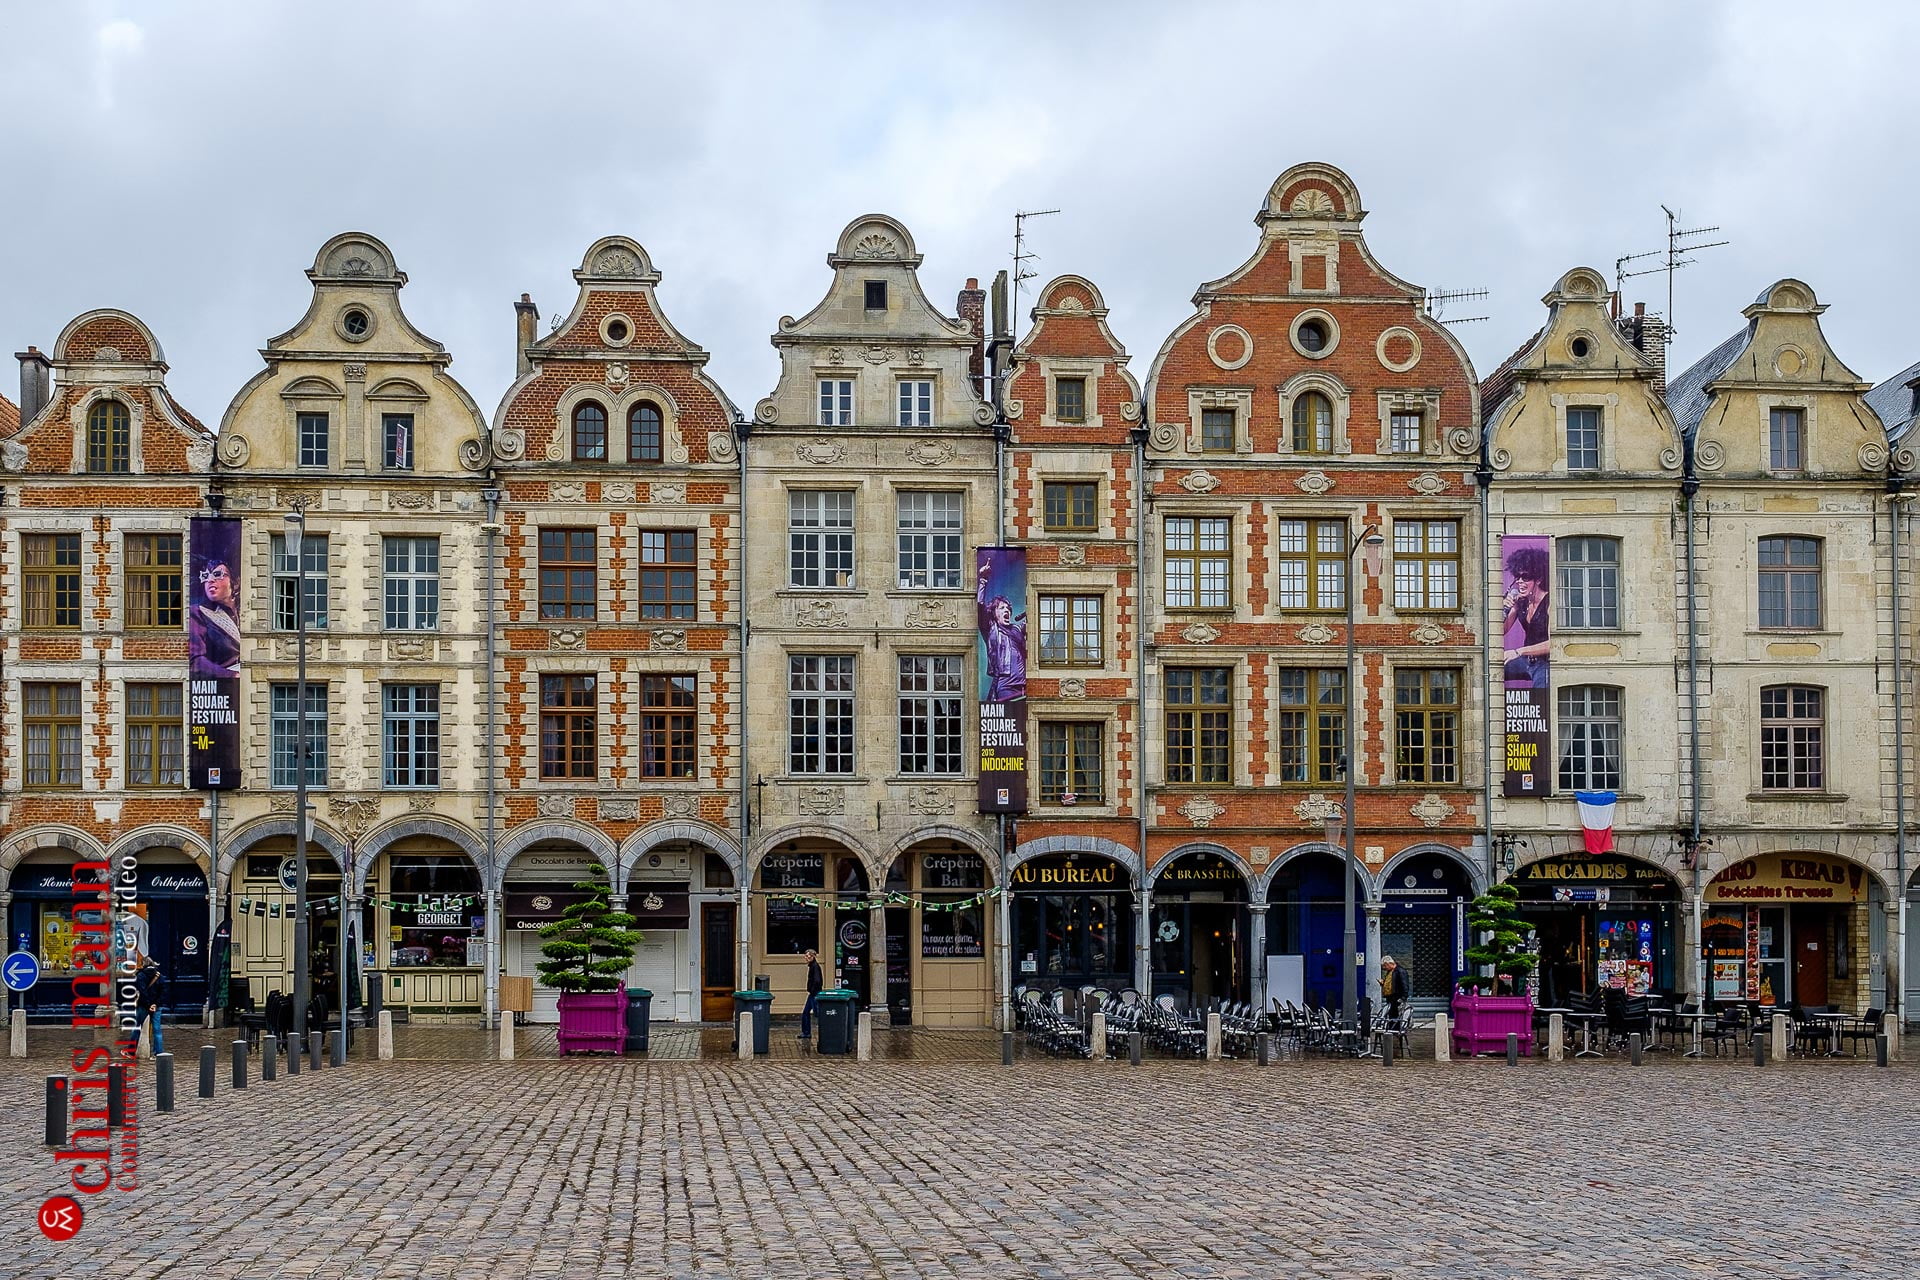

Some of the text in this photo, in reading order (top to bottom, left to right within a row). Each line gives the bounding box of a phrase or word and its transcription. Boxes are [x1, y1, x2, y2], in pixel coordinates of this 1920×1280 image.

[192, 681, 217, 694] MAIN
[192, 696, 230, 709] SQUARE
[1506, 691, 1530, 704] MAIN
[981, 704, 1004, 717] MAIN
[1506, 705, 1540, 718] SQUARE
[192, 711, 237, 724] FESTIVAL
[192, 726, 206, 734] 2010
[981, 719, 1016, 732] SQUARE
[1506, 719, 1548, 732] FESTIVAL
[981, 733, 1024, 746] FESTIVAL
[982, 749, 994, 757] 2013
[1507, 744, 1538, 757] SHAKA
[982, 758, 1024, 771] INDOCHINE
[1507, 758, 1531, 771] PONK
[762, 856, 822, 872] Crêperie
[923, 856, 982, 872] Crêperie
[1012, 868, 1115, 883] AU BUREAU
[1163, 870, 1173, 880] &
[1528, 864, 1628, 879] ARCADES
[1781, 859, 1845, 884] KEBAB
[152, 876, 204, 891] Orthopédie
[782, 874, 805, 886] Bar
[941, 874, 965, 886] Bar
[418, 913, 463, 924] GEORGET
